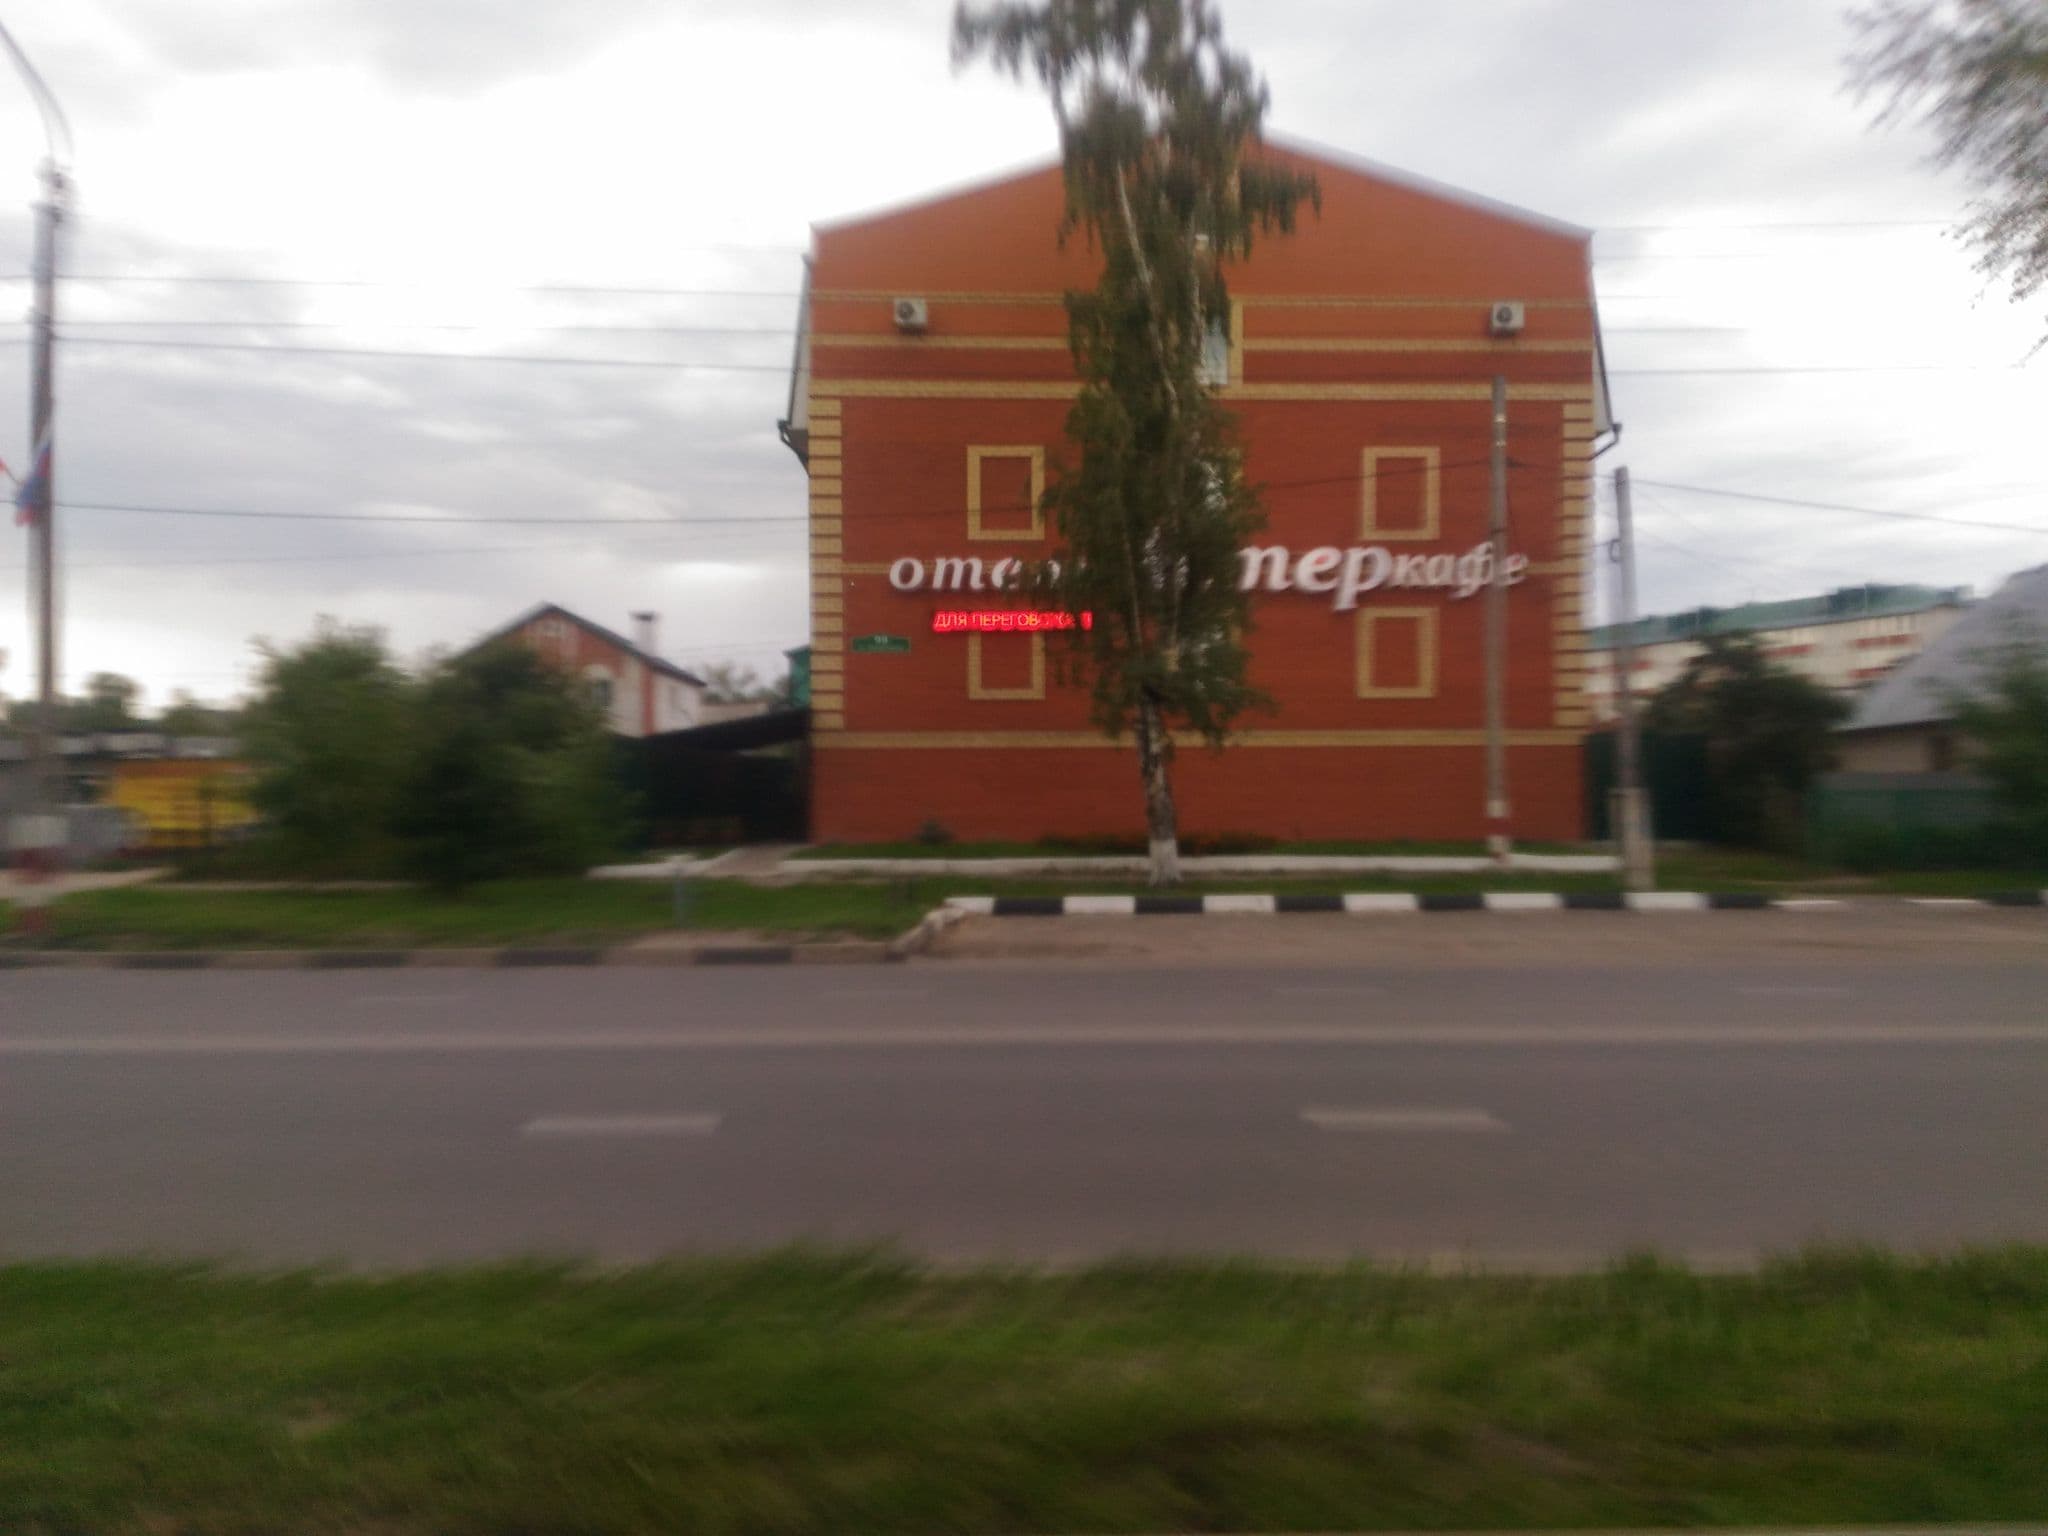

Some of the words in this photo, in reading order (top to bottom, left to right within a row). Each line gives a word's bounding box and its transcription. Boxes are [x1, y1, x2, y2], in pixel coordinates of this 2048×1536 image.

[888, 555, 1088, 591] оте
[935, 611, 968, 629] ДЛЯ
[972, 610, 1075, 630] ПЕРЕГОВ
